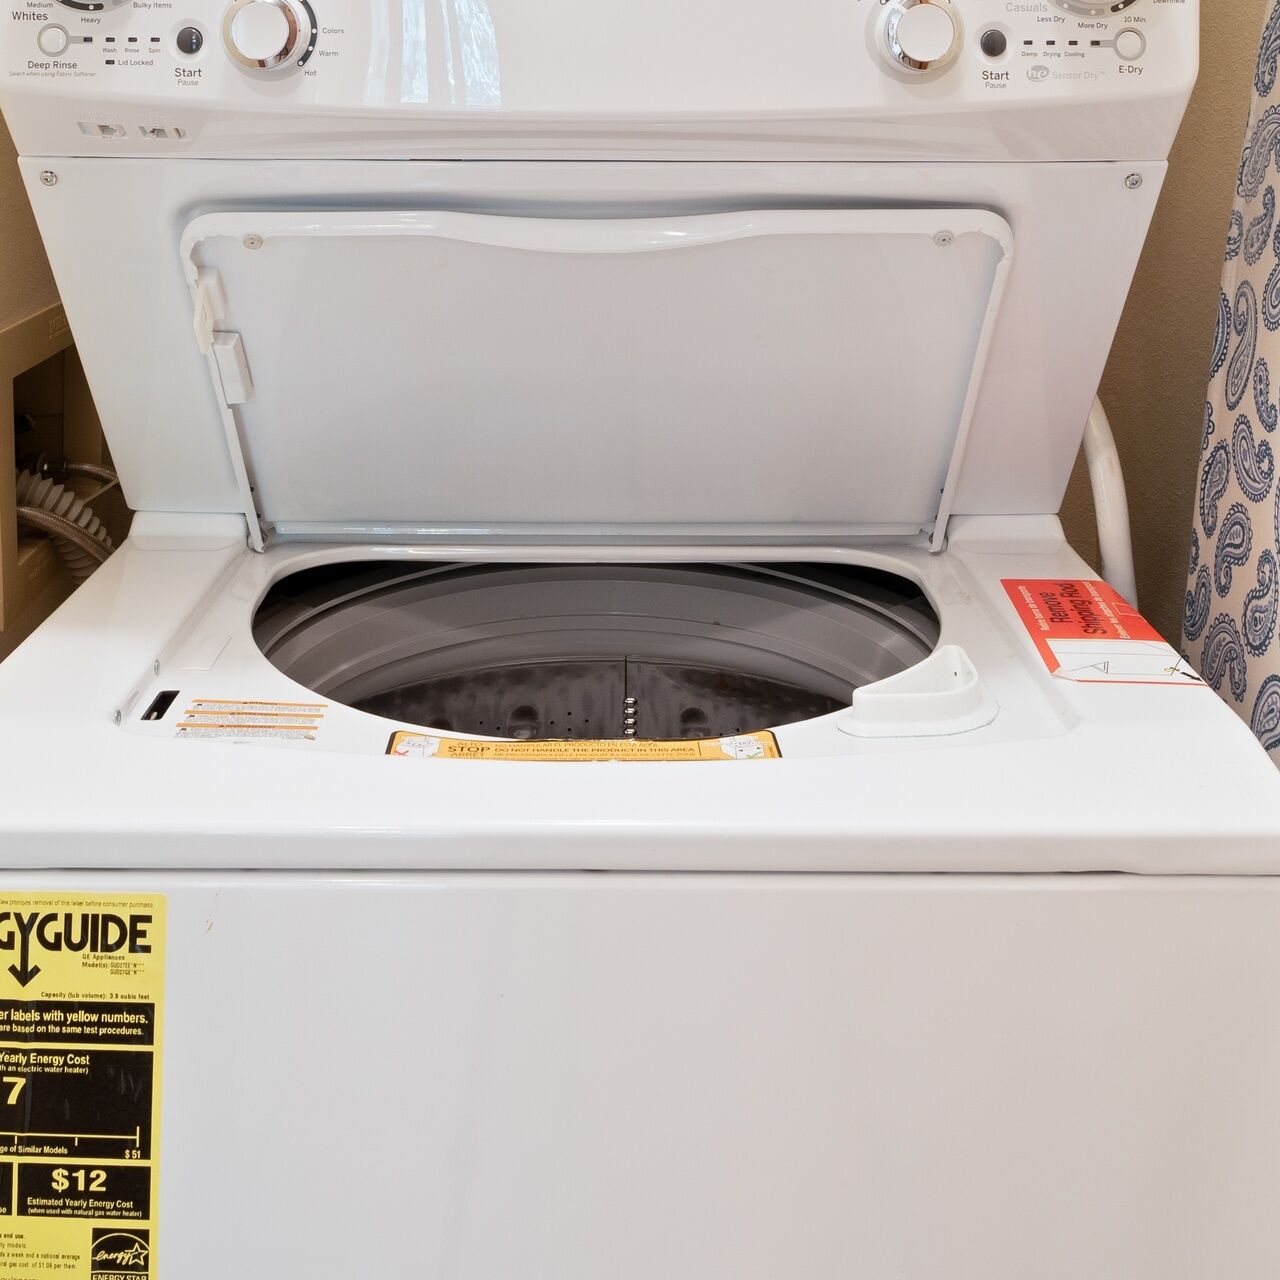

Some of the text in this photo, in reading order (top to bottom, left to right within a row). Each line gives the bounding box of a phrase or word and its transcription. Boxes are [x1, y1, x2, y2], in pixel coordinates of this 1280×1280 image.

[133, 2, 152, 10] Bulky
[1005, 2, 1048, 12] Casuals
[12, 11, 48, 22] Whites
[80, 17, 101, 25] Heavy
[1054, 15, 1066, 24] Dry
[1096, 22, 1108, 31] Dry
[148, 47, 161, 55] Spin
[27, 60, 78, 71] Deep Rinse
[1119, 65, 1143, 75] E-Dry
[174, 67, 202, 78] Start
[982, 70, 1010, 81] Start
[1053, 583, 1082, 598] Rod
[1039, 592, 1073, 624] Remove
[1069, 600, 1108, 634] Shipping
[11, 1009, 40, 1021] labels
[43, 1010, 64, 1021] with
[67, 1010, 99, 1024] yellow
[101, 1011, 148, 1024] numbers.
[12, 1023, 35, 1033] based
[37, 1025, 46, 1033] on
[48, 1025, 60, 1033] the
[62, 1026, 82, 1034] same
[84, 1026, 98, 1034] test
[99, 1027, 144, 1036] procedures.
[30, 1053, 64, 1066] Energy
[67, 1054, 90, 1065] Cost
[9, 1144, 17, 1152] of
[18, 1145, 42, 1154] Similar
[43, 1146, 68, 1154] Models
[51, 1168, 107, 1193] $12
[27, 1197, 133, 1210] Estimated Yearly Energy Cost
